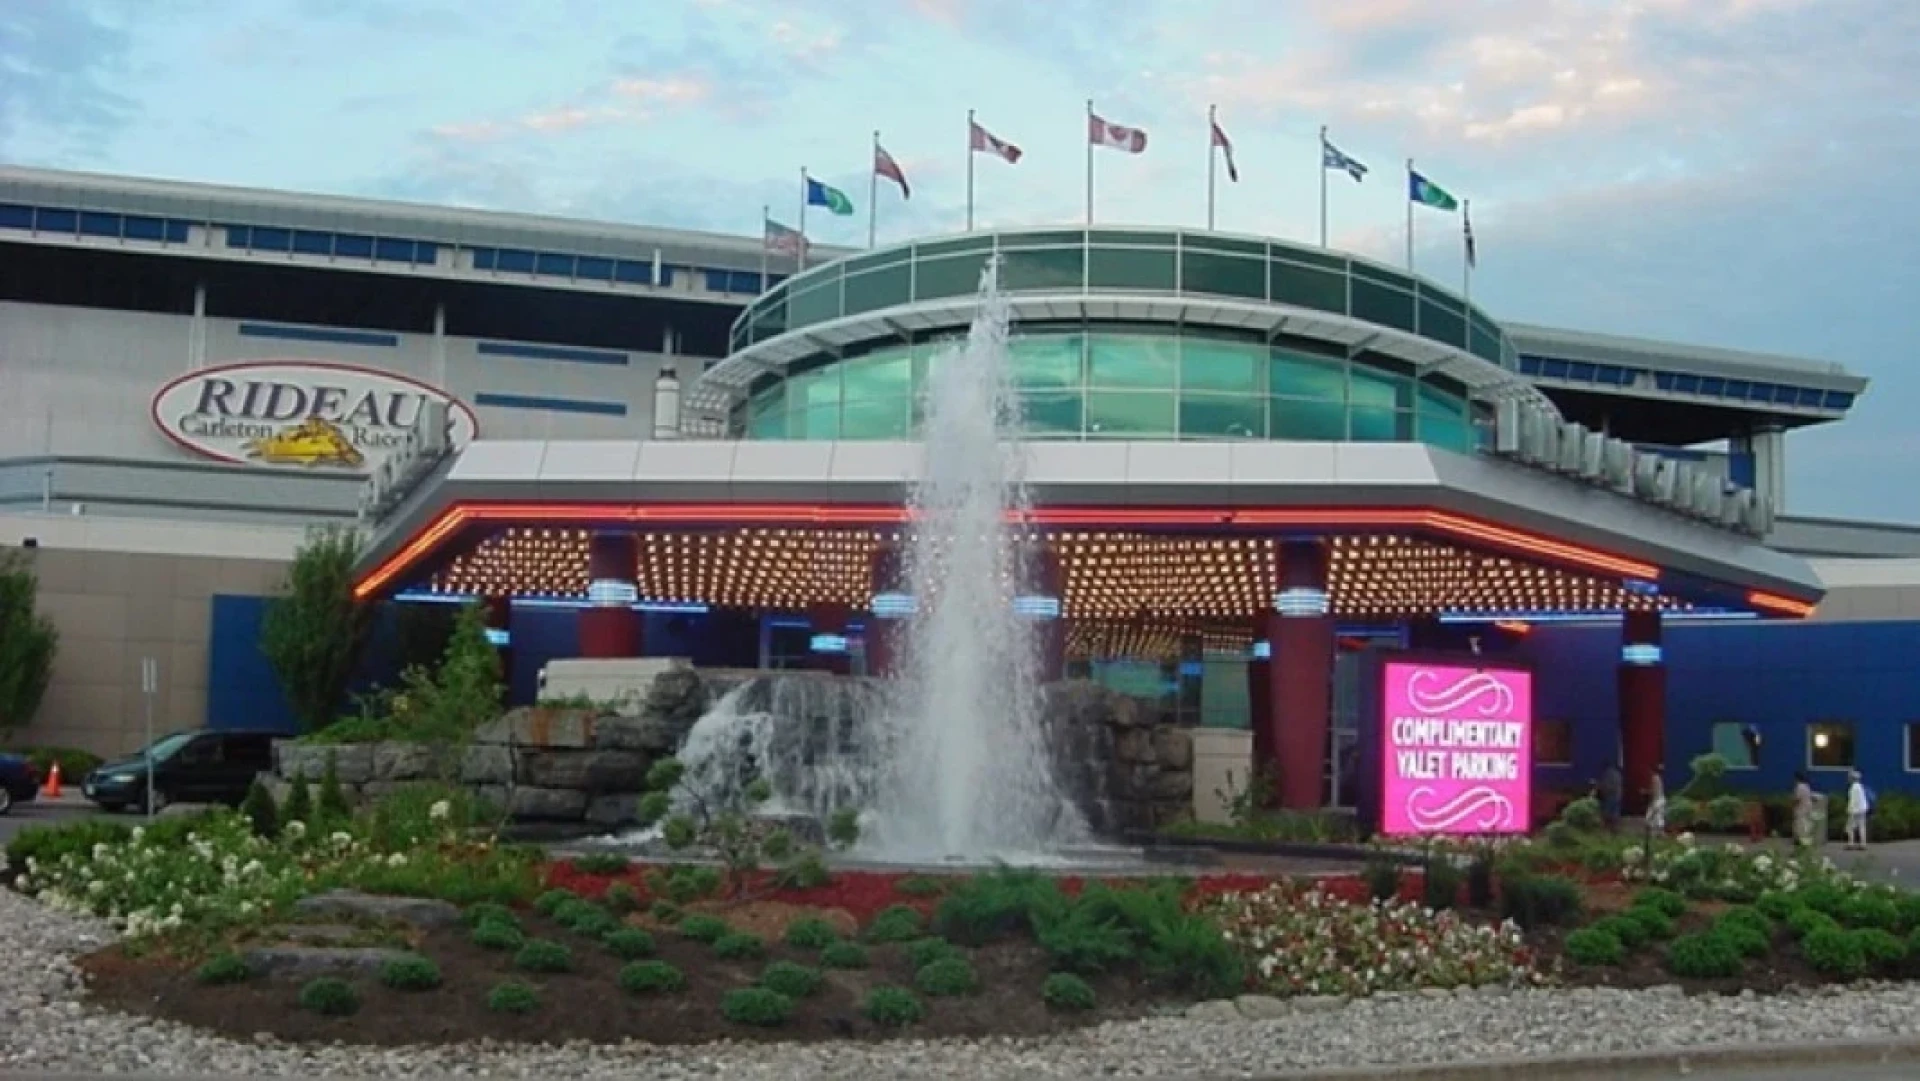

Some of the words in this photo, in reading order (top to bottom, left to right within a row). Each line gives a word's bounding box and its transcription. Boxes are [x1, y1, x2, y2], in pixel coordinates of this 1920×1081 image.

[196, 379, 426, 429] RIDEAU
[178, 414, 273, 438] Carleton
[352, 426, 403, 447] Race
[1392, 716, 1523, 748] COMPLIMENTARY
[1397, 750, 1447, 779] VALET
[1451, 752, 1519, 780] PARKING
